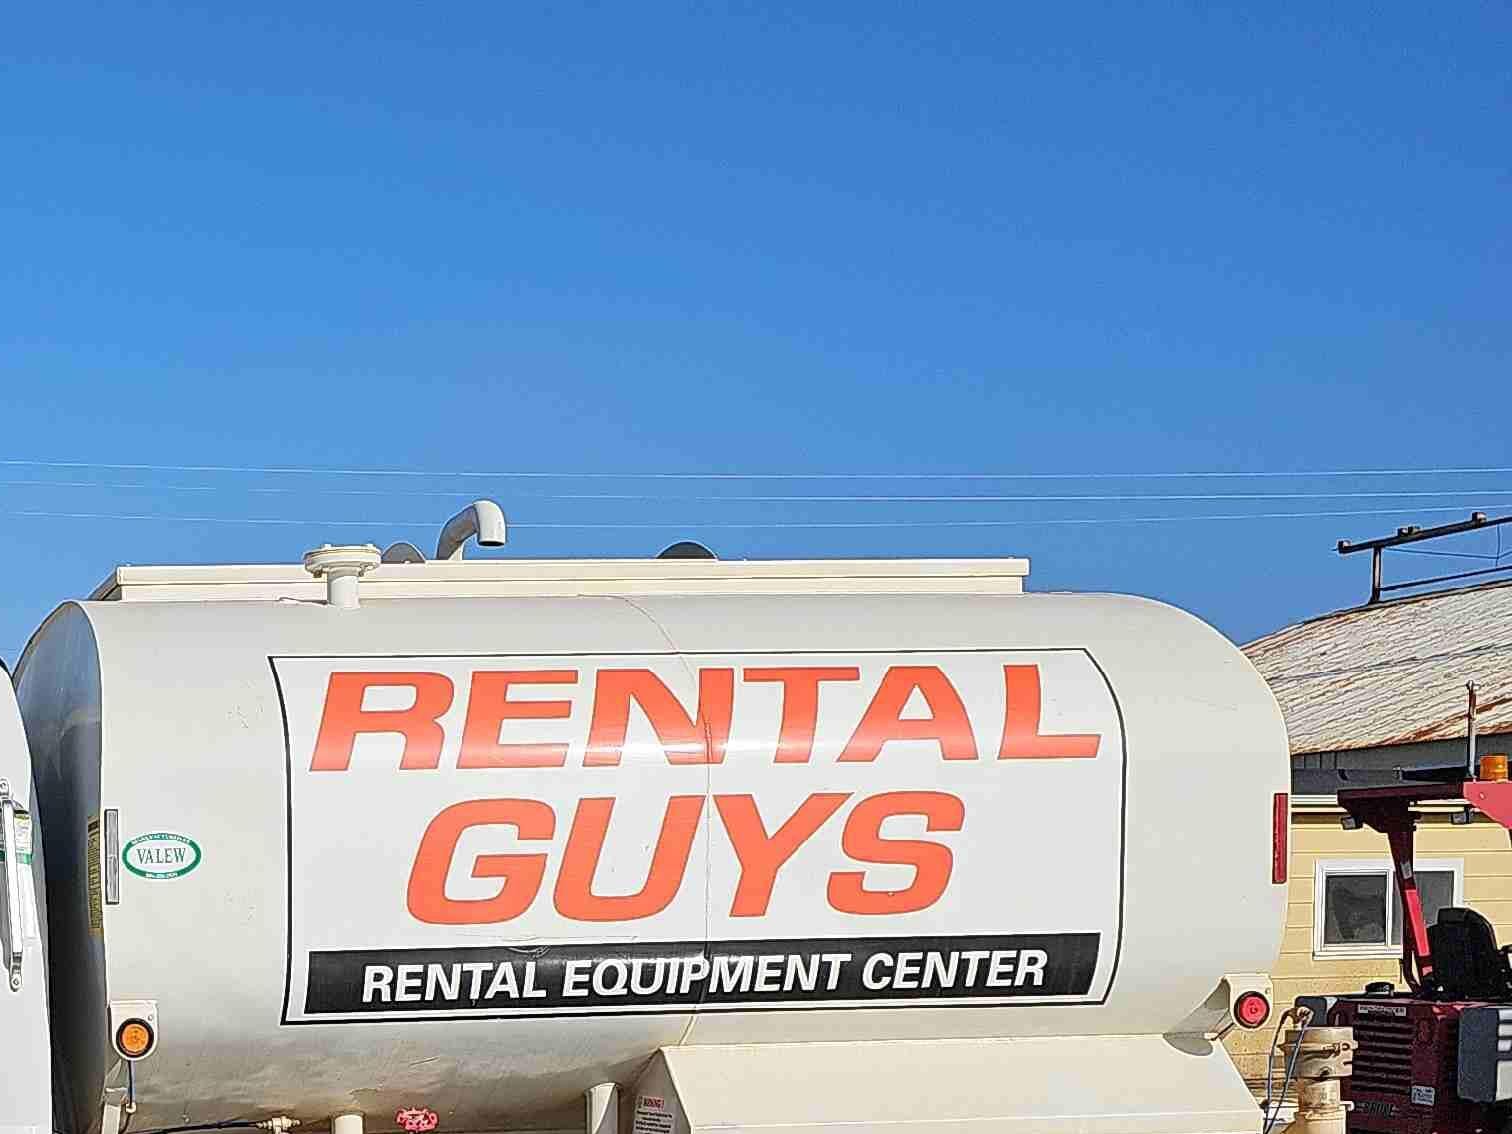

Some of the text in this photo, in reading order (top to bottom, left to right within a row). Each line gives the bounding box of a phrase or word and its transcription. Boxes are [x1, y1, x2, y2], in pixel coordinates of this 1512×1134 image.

[311, 662, 1101, 772] RENTAL
[136, 847, 186, 864] VALEW
[406, 790, 965, 926] GUYS
[361, 949, 1048, 1003] RENTAL EQUIPMENT CENTER
